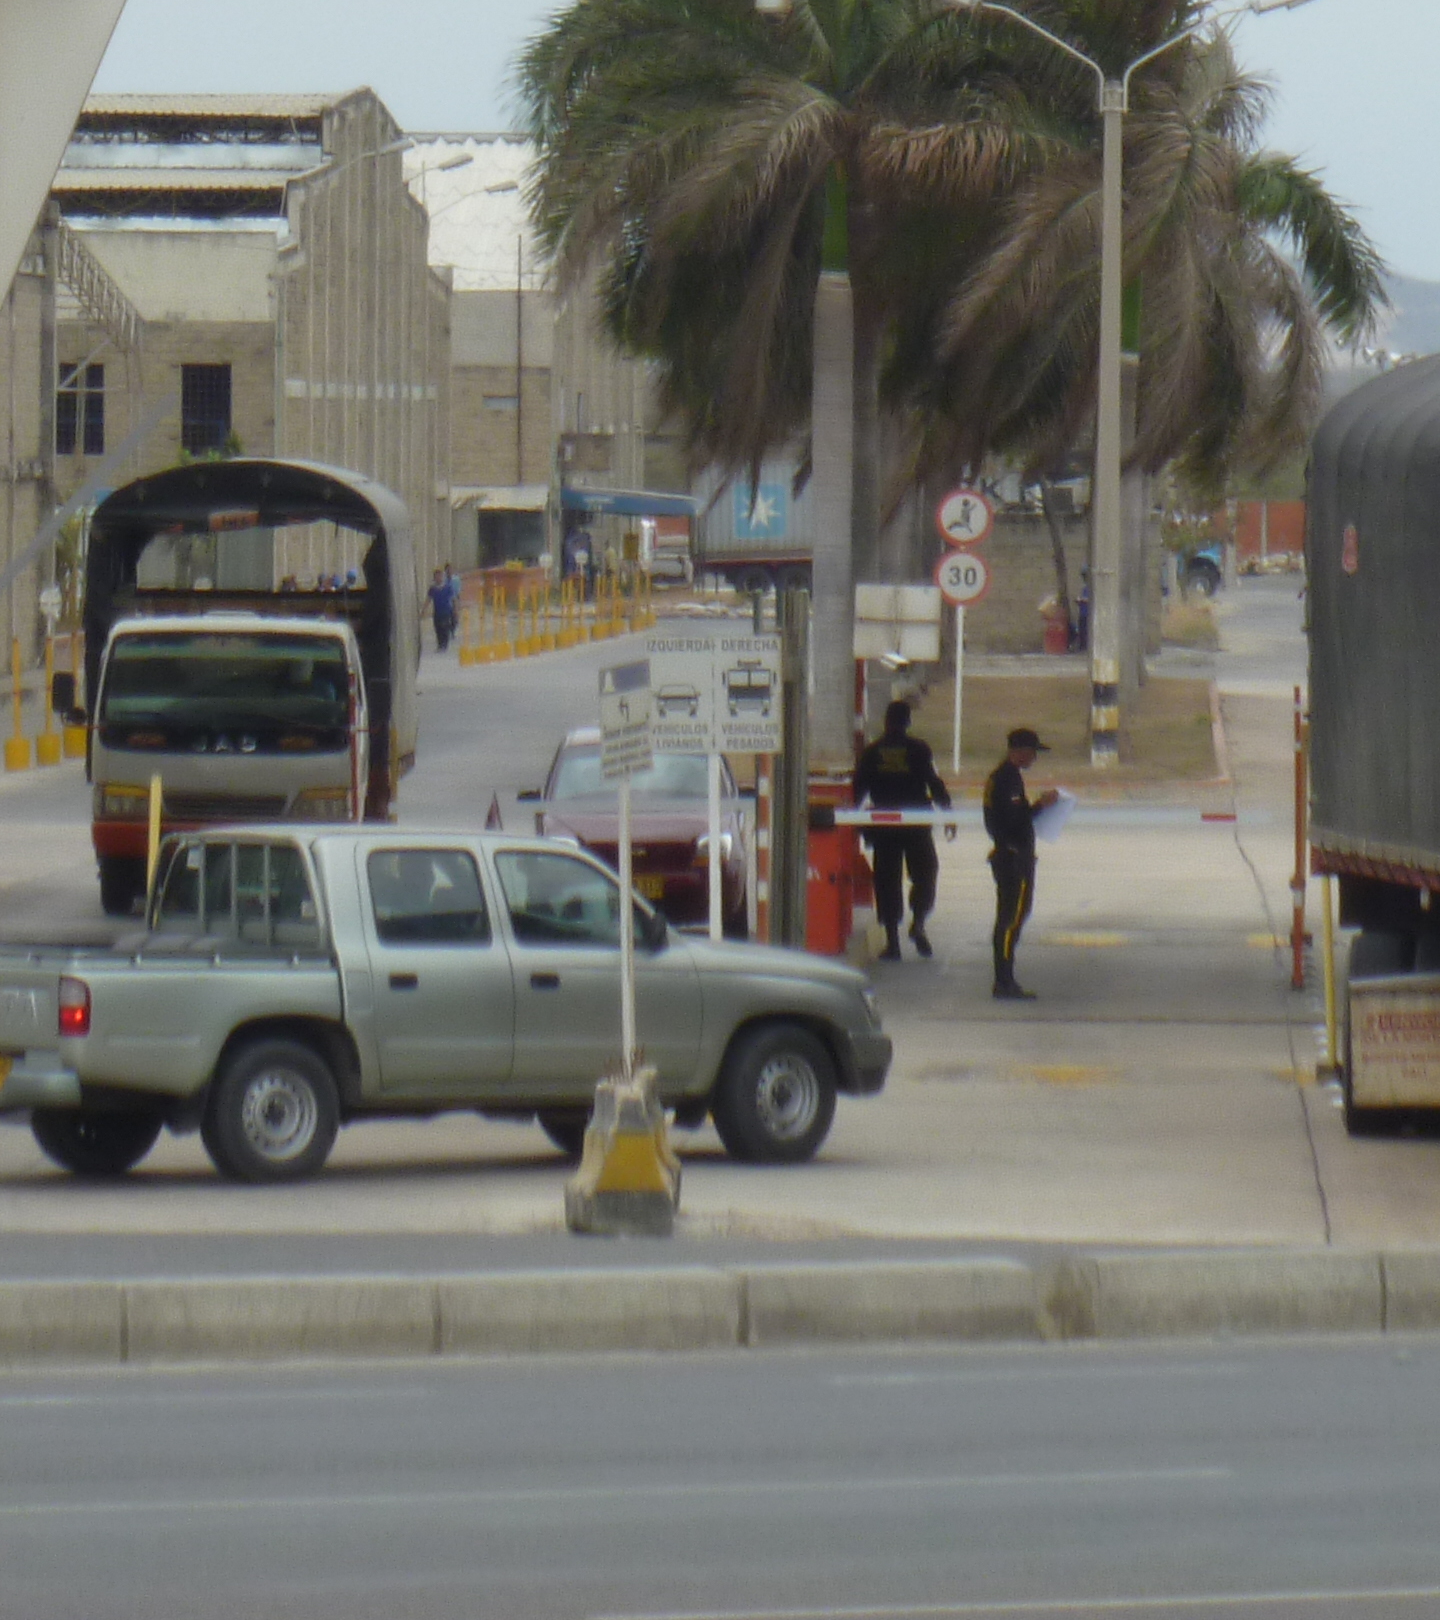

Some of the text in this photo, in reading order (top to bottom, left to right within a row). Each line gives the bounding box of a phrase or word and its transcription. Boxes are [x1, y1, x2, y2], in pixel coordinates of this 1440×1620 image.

[949, 566, 977, 586] 30
[646, 638, 710, 653] IZQUIERDA
[720, 638, 779, 652] DERECHA
